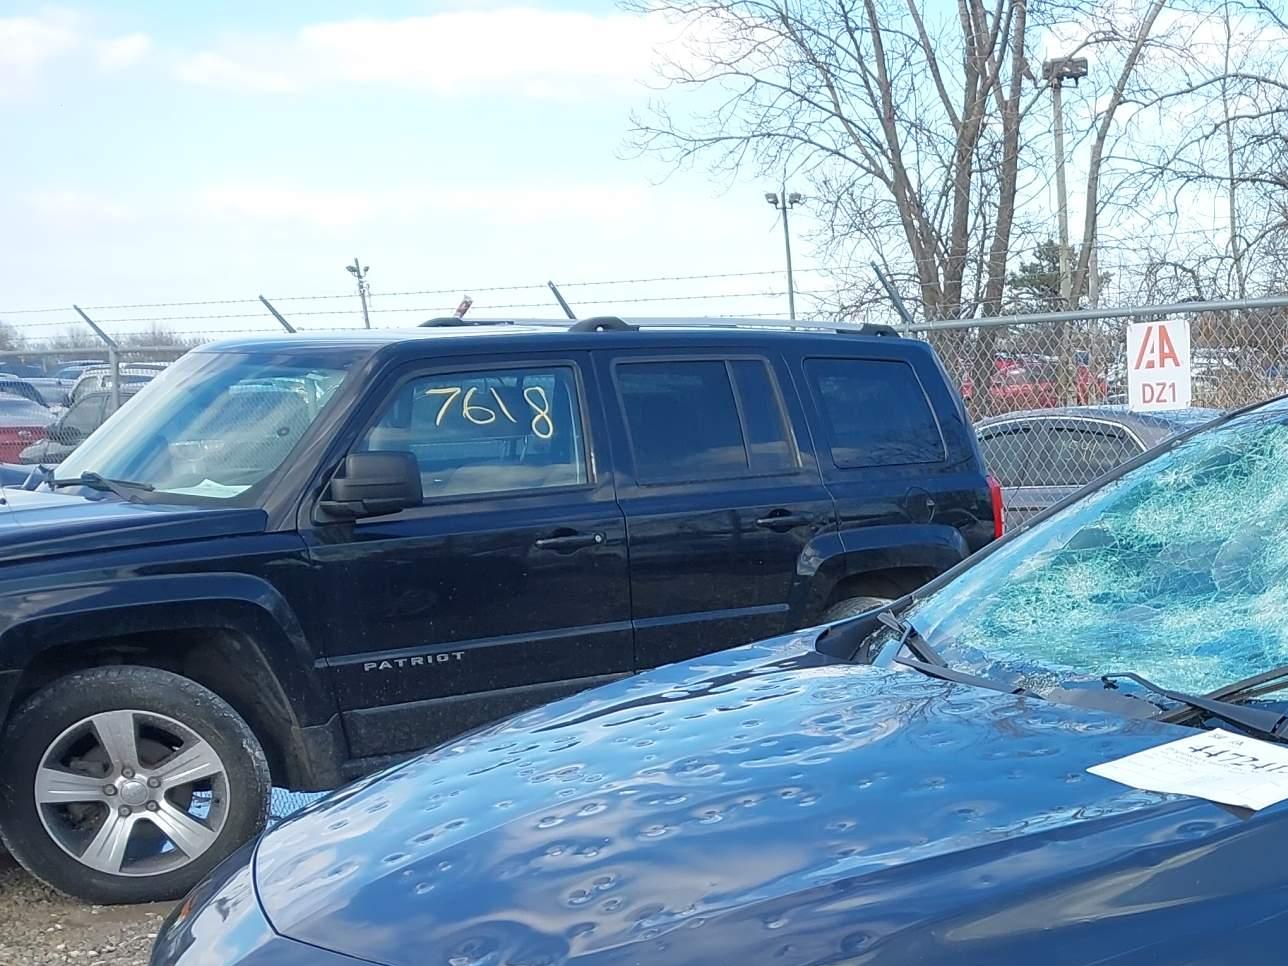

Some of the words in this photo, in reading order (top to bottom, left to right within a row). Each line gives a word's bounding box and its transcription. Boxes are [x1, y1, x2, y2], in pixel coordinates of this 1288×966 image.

[1142, 382, 1176, 404] DZ1
[426, 387, 554, 439] 7618
[363, 651, 465, 671] PATRIOT
